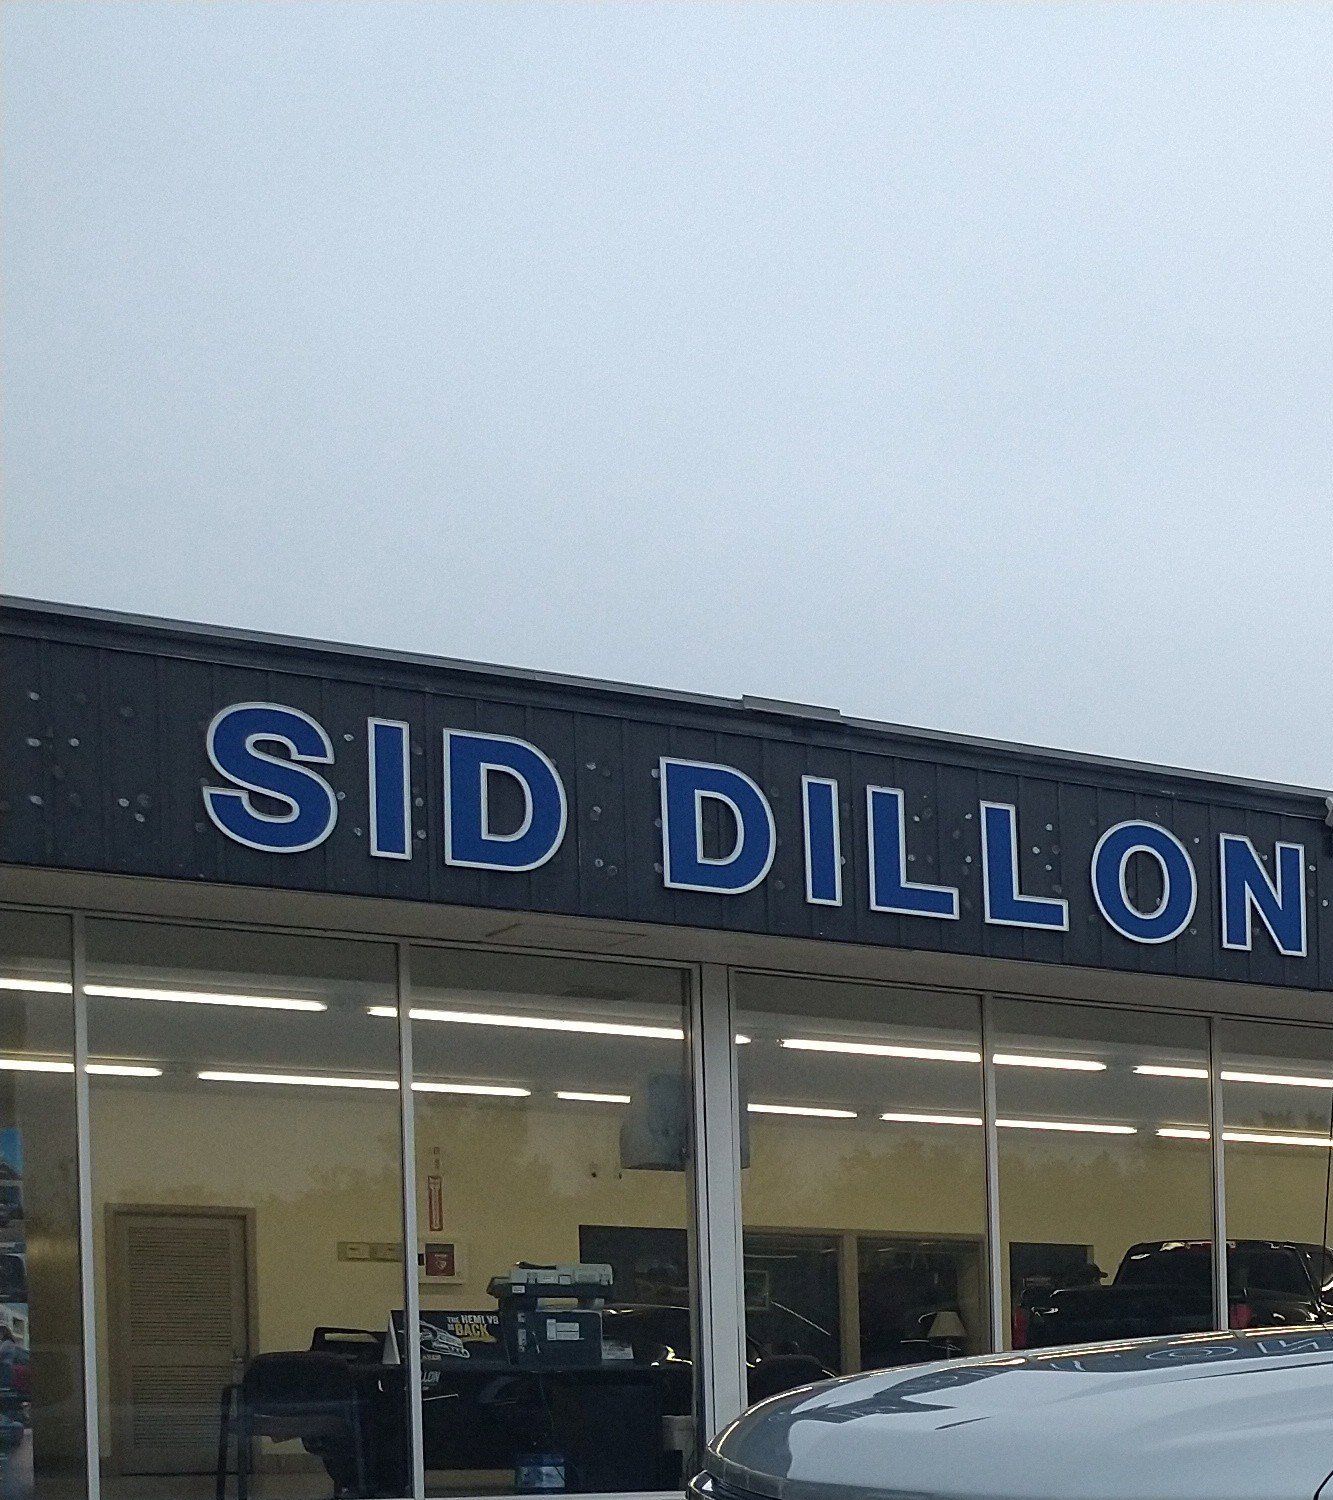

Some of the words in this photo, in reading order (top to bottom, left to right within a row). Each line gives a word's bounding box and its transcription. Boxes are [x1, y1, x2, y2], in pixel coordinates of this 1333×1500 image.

[203, 702, 568, 872] SID
[660, 756, 1307, 957] DILLON
[461, 1314, 486, 1324] HEMI
[487, 1315, 500, 1325] V8
[455, 1323, 488, 1338] BACK
